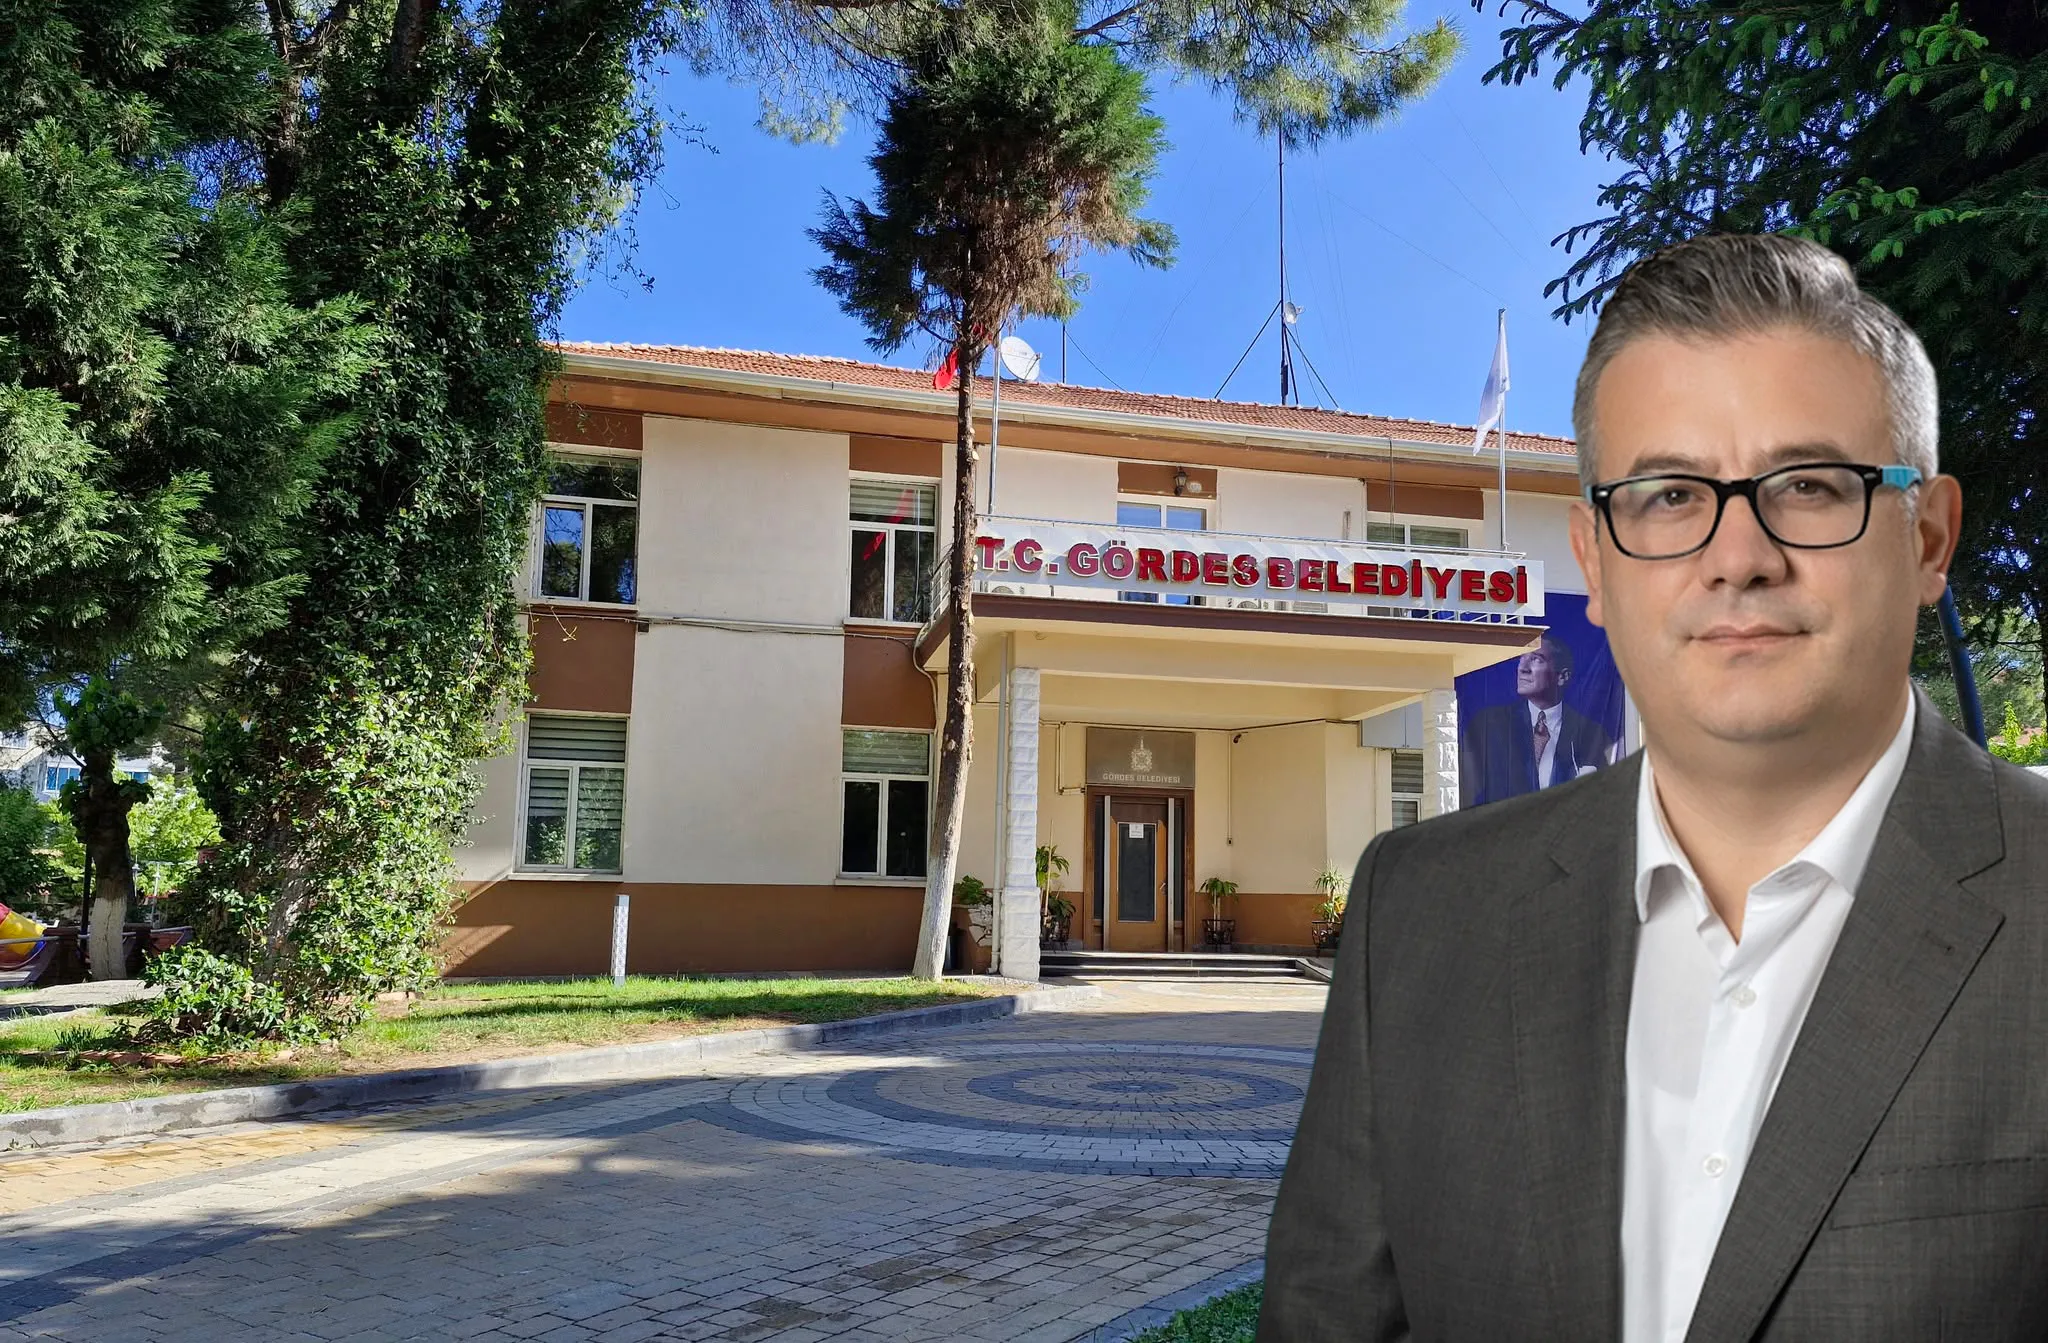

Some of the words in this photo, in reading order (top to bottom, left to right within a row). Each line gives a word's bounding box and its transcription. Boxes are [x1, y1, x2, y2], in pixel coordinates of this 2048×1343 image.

[976, 536, 1058, 574] T.C.
[1067, 540, 1260, 588] GÖRDES
[1267, 557, 1528, 604] BELEDİYESİ
